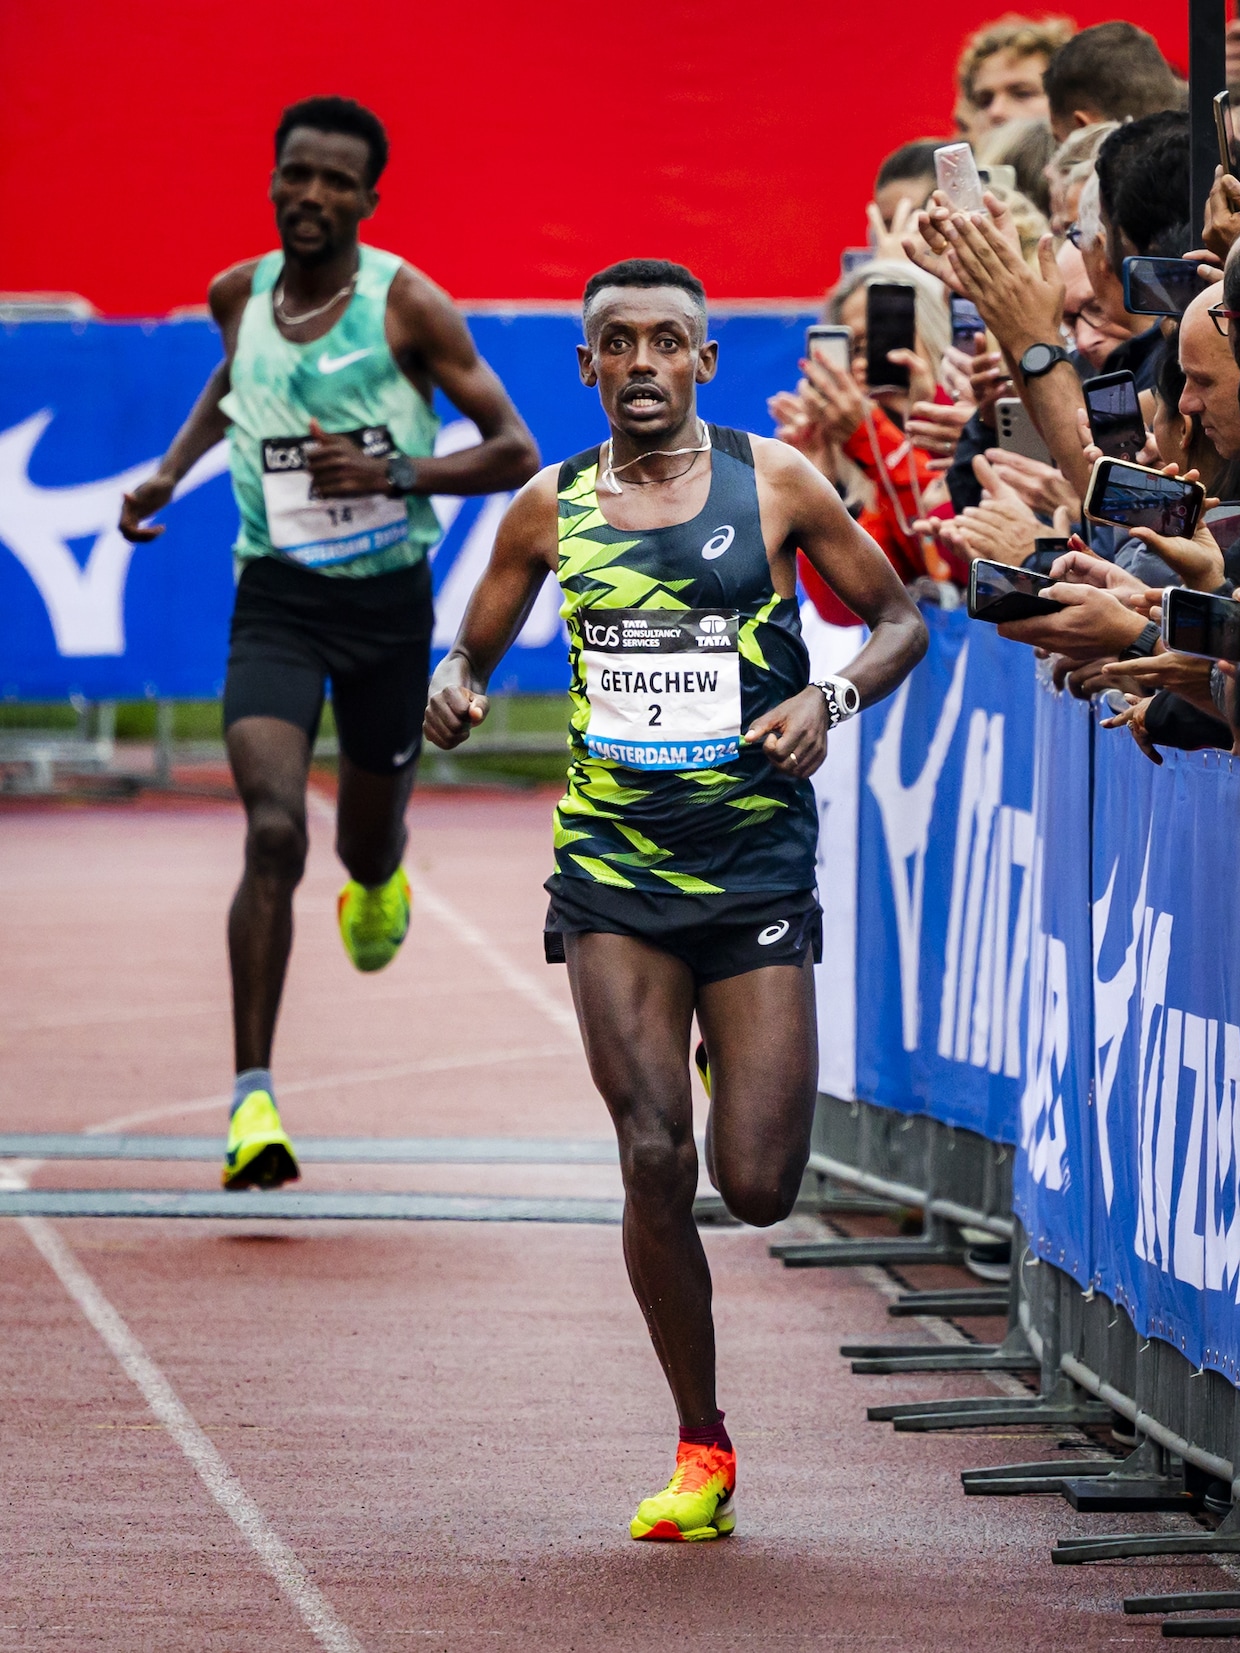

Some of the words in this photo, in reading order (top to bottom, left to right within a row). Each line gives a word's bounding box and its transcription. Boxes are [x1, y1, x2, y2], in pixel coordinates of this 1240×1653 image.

[326, 507, 352, 527] 14
[585, 620, 619, 647] tcs
[622, 629, 682, 639] CONSULTANCY
[622, 620, 648, 629] TATA
[622, 638, 660, 648] SERVICES
[695, 635, 731, 647] TATA
[601, 669, 718, 693] GETACHEW
[648, 704, 662, 726] 2
[588, 740, 687, 765] AMSTERDAM
